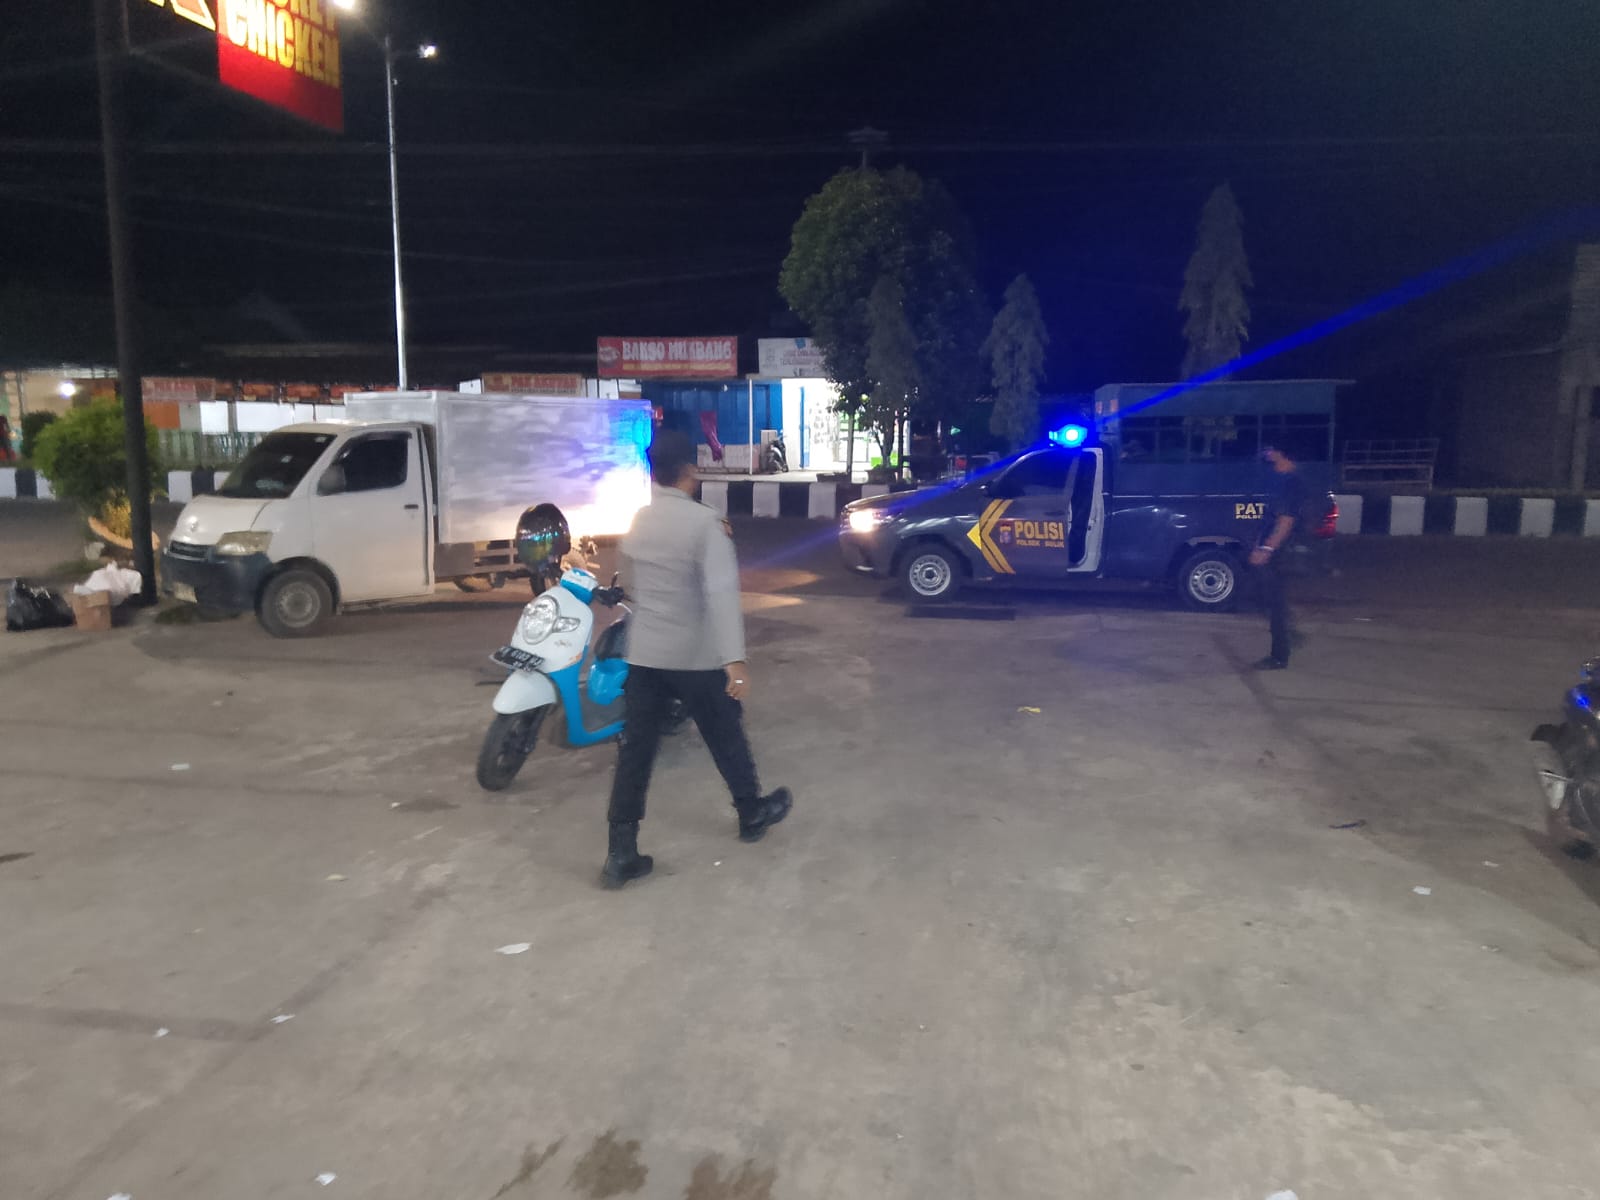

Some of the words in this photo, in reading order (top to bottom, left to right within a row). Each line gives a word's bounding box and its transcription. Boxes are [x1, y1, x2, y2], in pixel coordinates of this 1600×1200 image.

[226, 0, 339, 88] CHICKEN
[623, 341, 665, 360] BAKSO
[1014, 521, 1065, 540] POLISI
